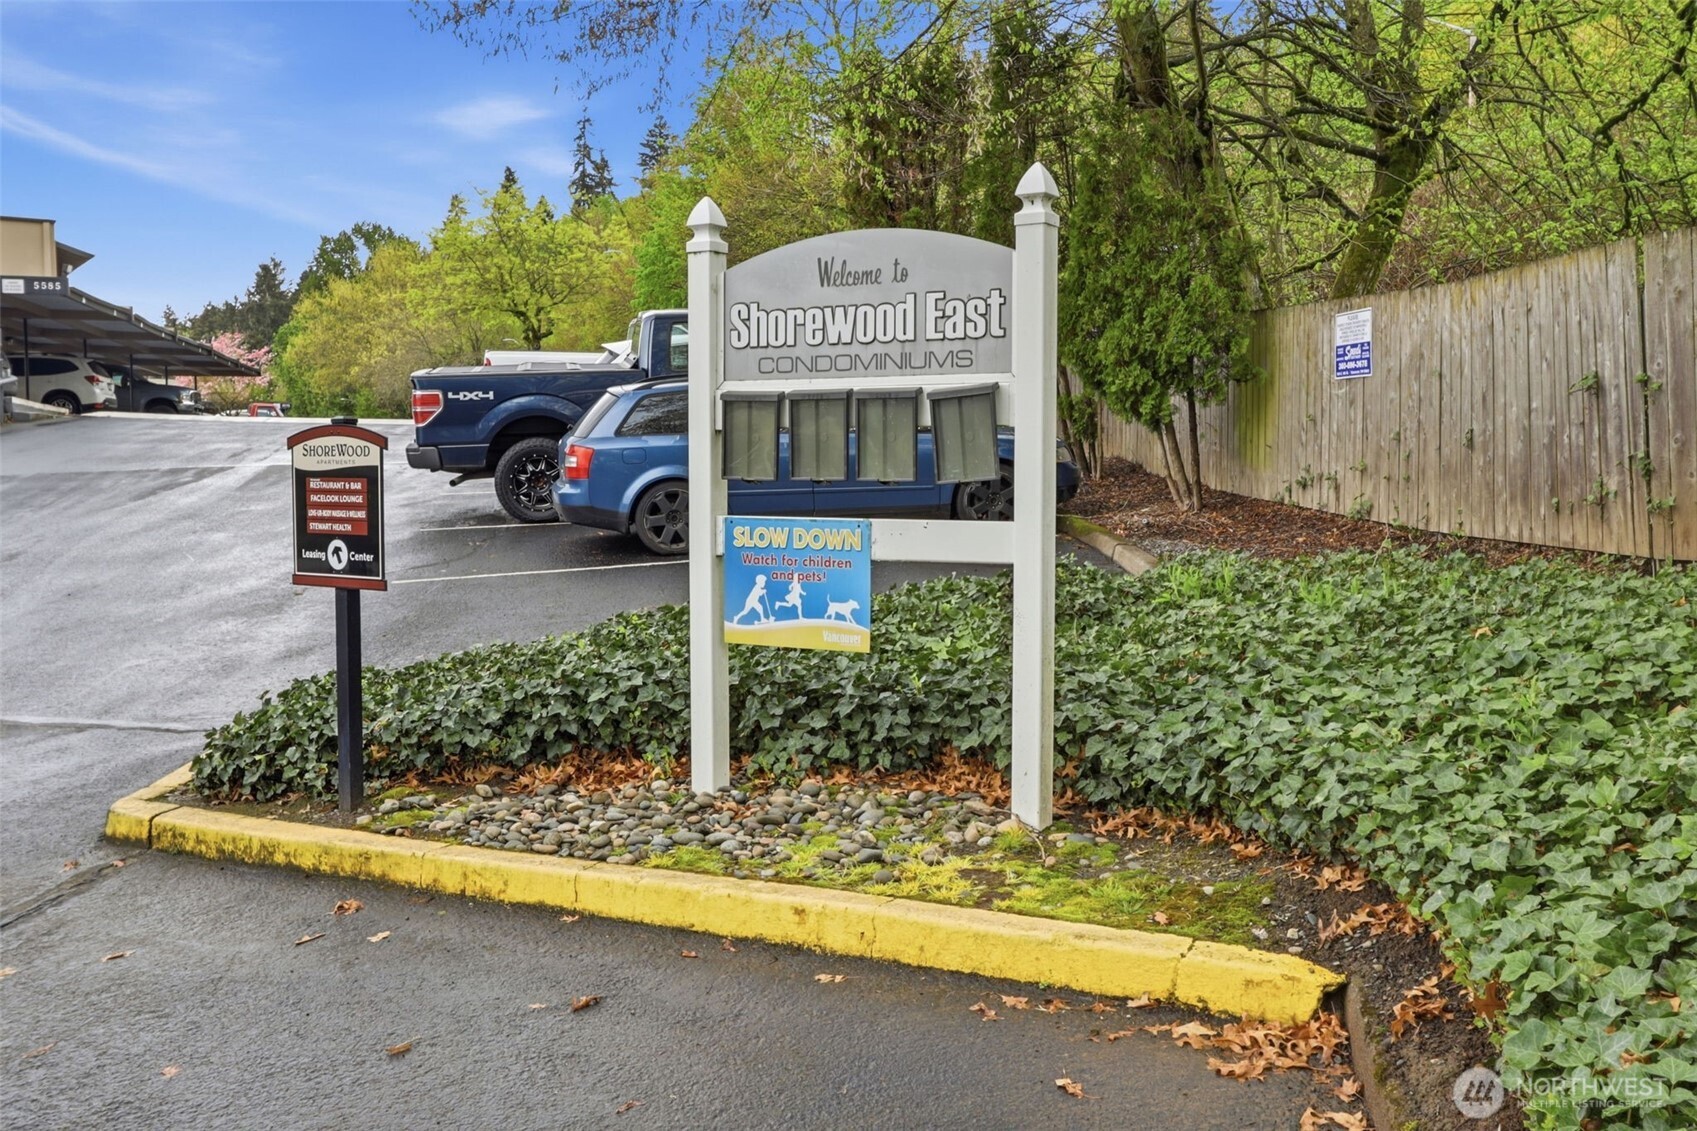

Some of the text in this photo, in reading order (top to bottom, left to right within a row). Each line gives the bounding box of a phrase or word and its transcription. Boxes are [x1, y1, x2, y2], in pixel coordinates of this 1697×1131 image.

[817, 256, 908, 288] Welcome to
[33, 281, 61, 290] 5585
[729, 288, 1006, 350] Shorewood East
[757, 349, 974, 374] CONDOMINIUMS
[302, 443, 371, 457] SHOREWOOD
[310, 481, 362, 490] RESTAURANT & BAR
[339, 495, 363, 503] LOUNGE
[309, 522, 352, 531] STEWART HEALTH
[733, 526, 863, 552] SLOW DOWN
[302, 548, 374, 562] Leasing Center
[742, 553, 852, 569] Watch for children
[771, 570, 826, 584] and pets!
[822, 630, 861, 645] Vancouver
